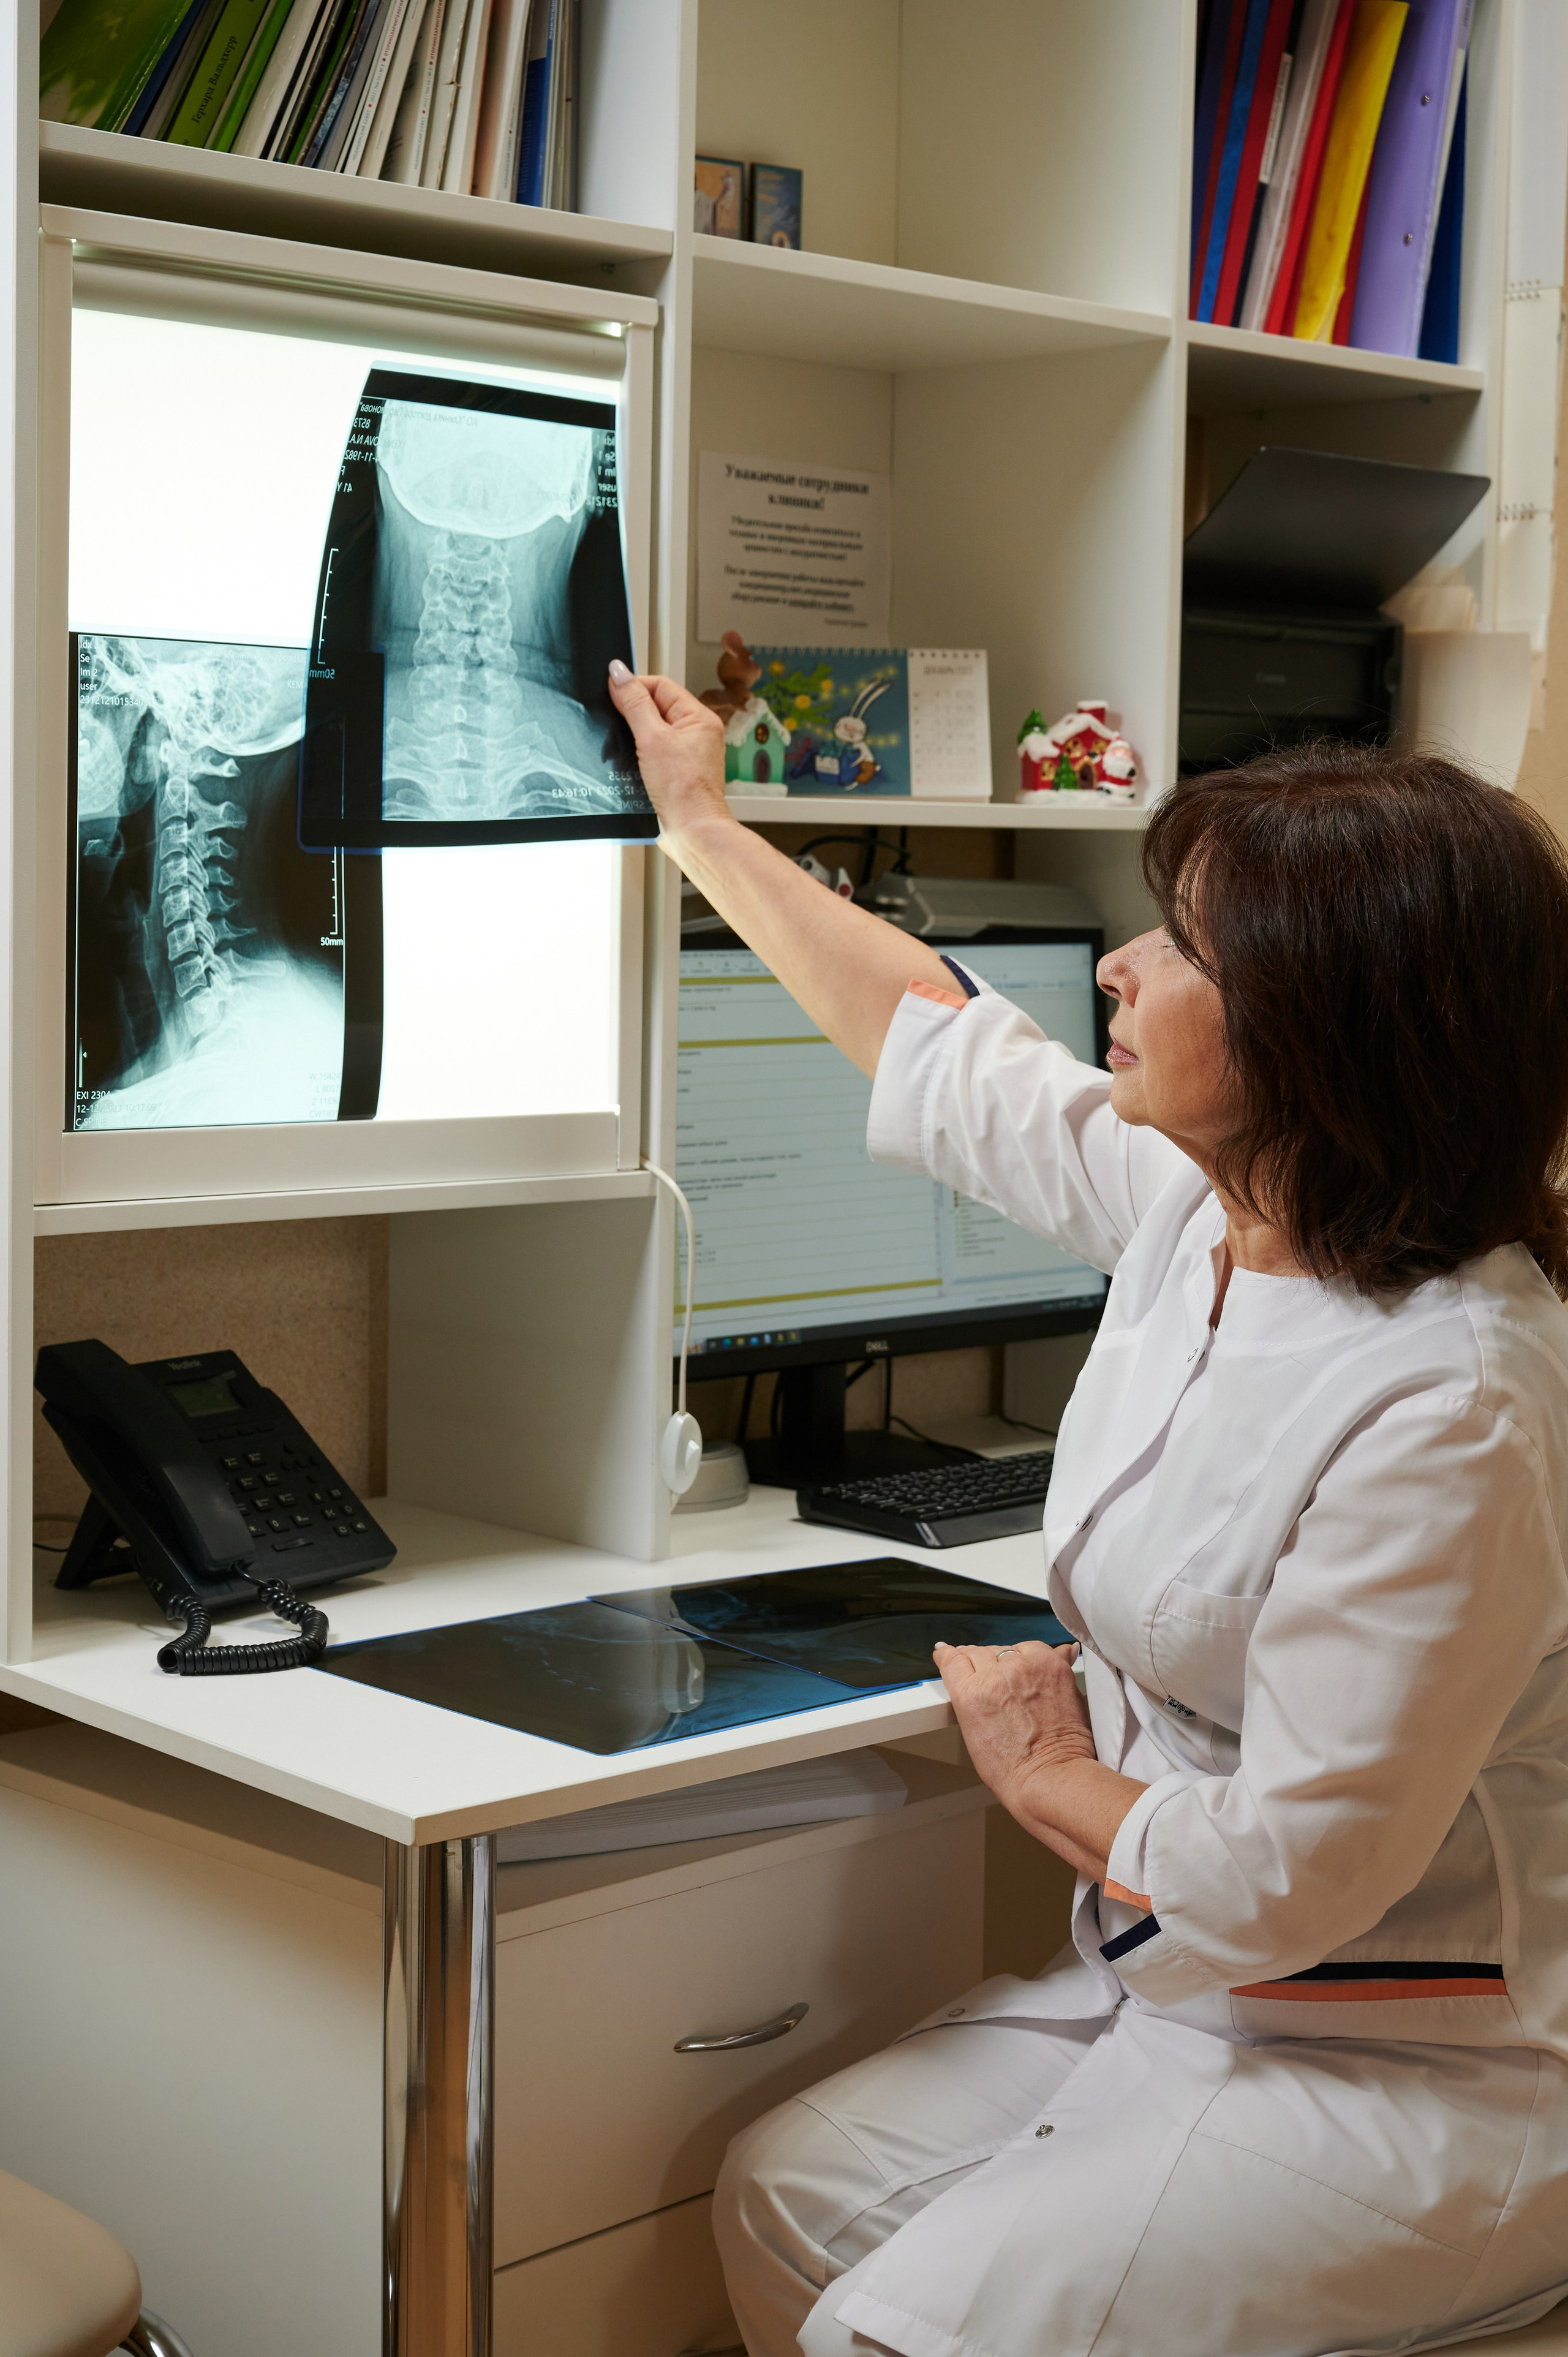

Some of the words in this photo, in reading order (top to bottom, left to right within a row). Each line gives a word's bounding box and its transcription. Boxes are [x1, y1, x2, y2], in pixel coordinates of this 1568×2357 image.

[190, 85, 216, 124] Герхард
[207, 34, 239, 86] Вальдхерр
[80, 639, 92, 649] Idx
[80, 654, 90, 662] Se
[80, 668, 91, 676] Im
[320, 937, 344, 946] 50mm
[77, 1091, 89, 1099] EXI
[91, 1090, 110, 1099] 2304
[77, 1104, 122, 1114] 12-12-2023
[75, 1118, 81, 1126] C
[84, 1118, 107, 1126] SPINE
